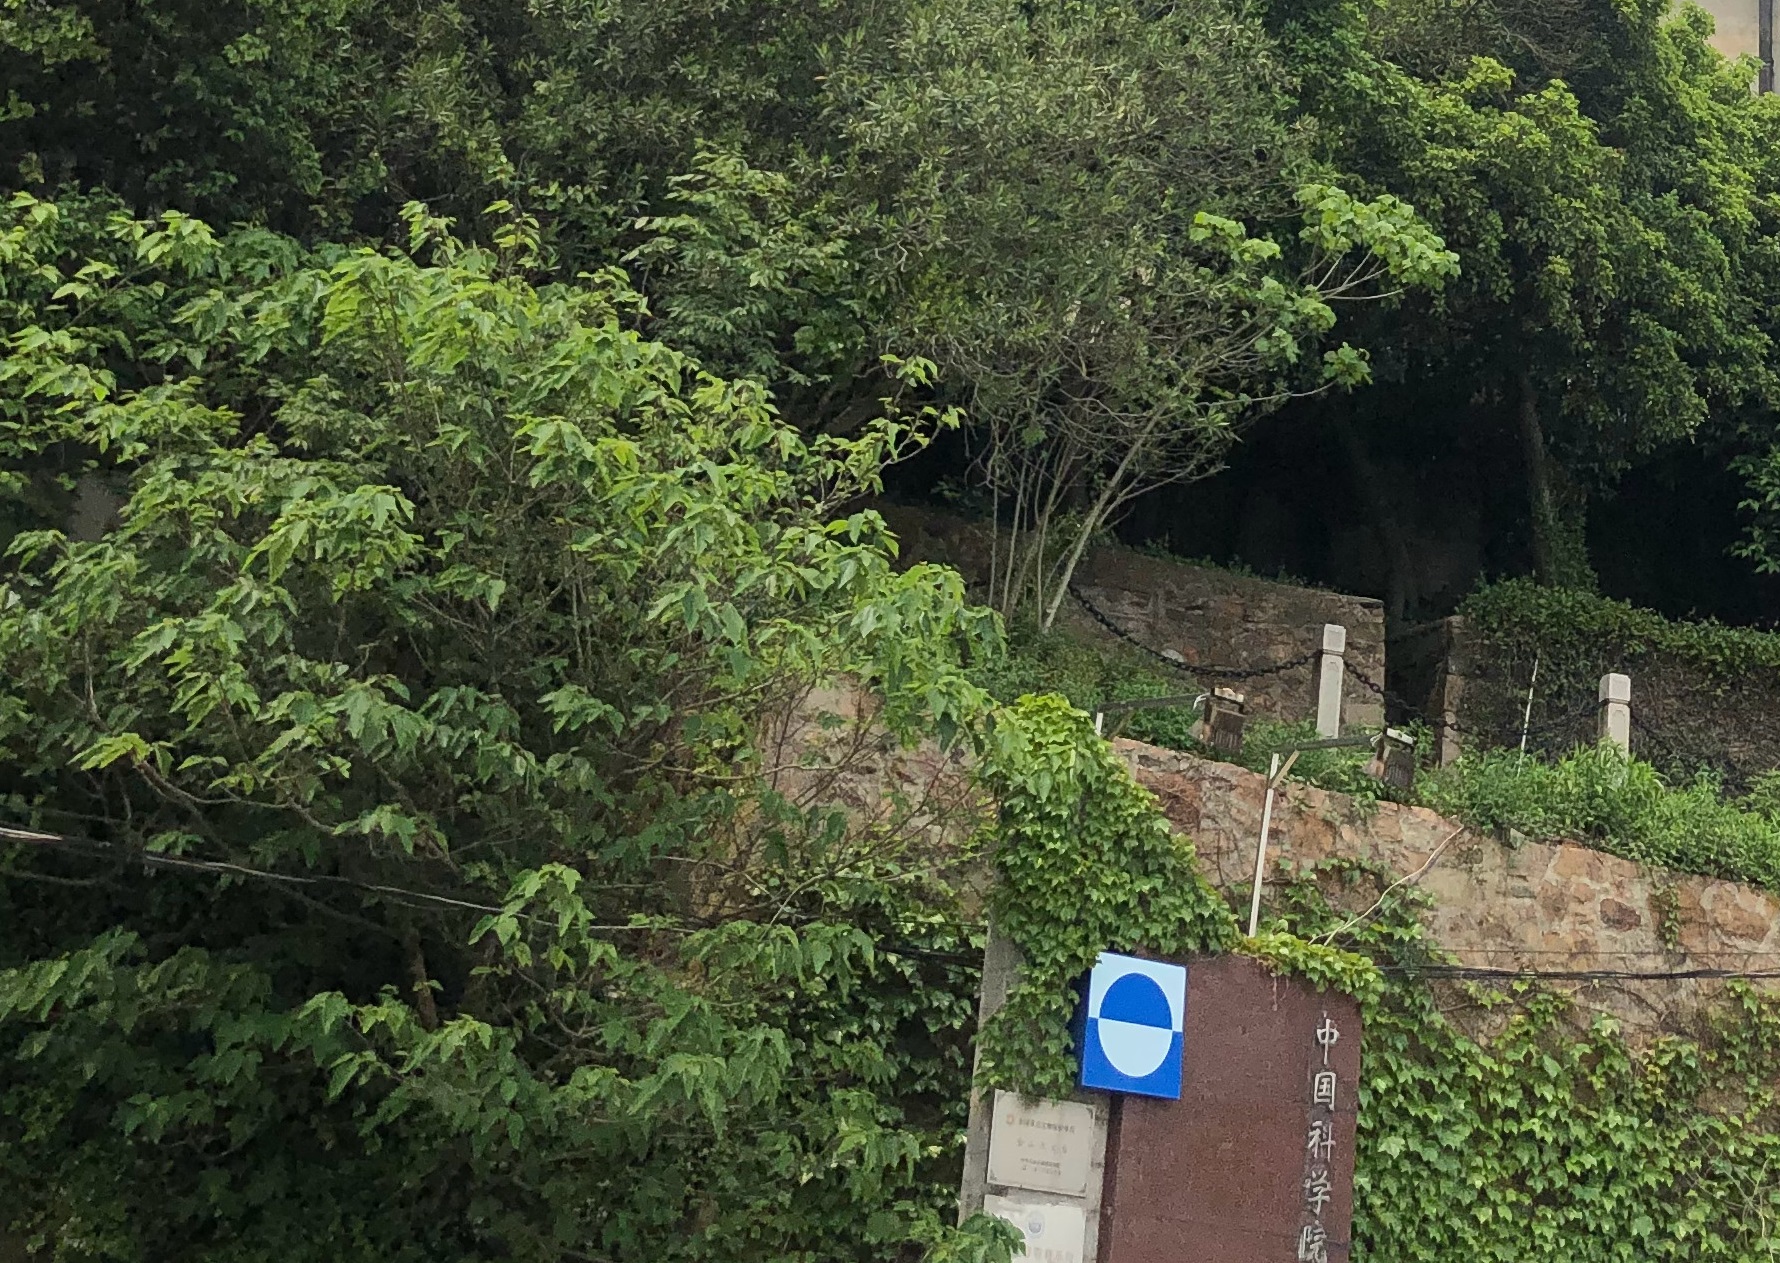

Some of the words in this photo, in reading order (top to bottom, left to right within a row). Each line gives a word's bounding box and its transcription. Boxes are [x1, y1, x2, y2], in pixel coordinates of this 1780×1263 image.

[1298, 1016, 1339, 1263] 中国科学院
